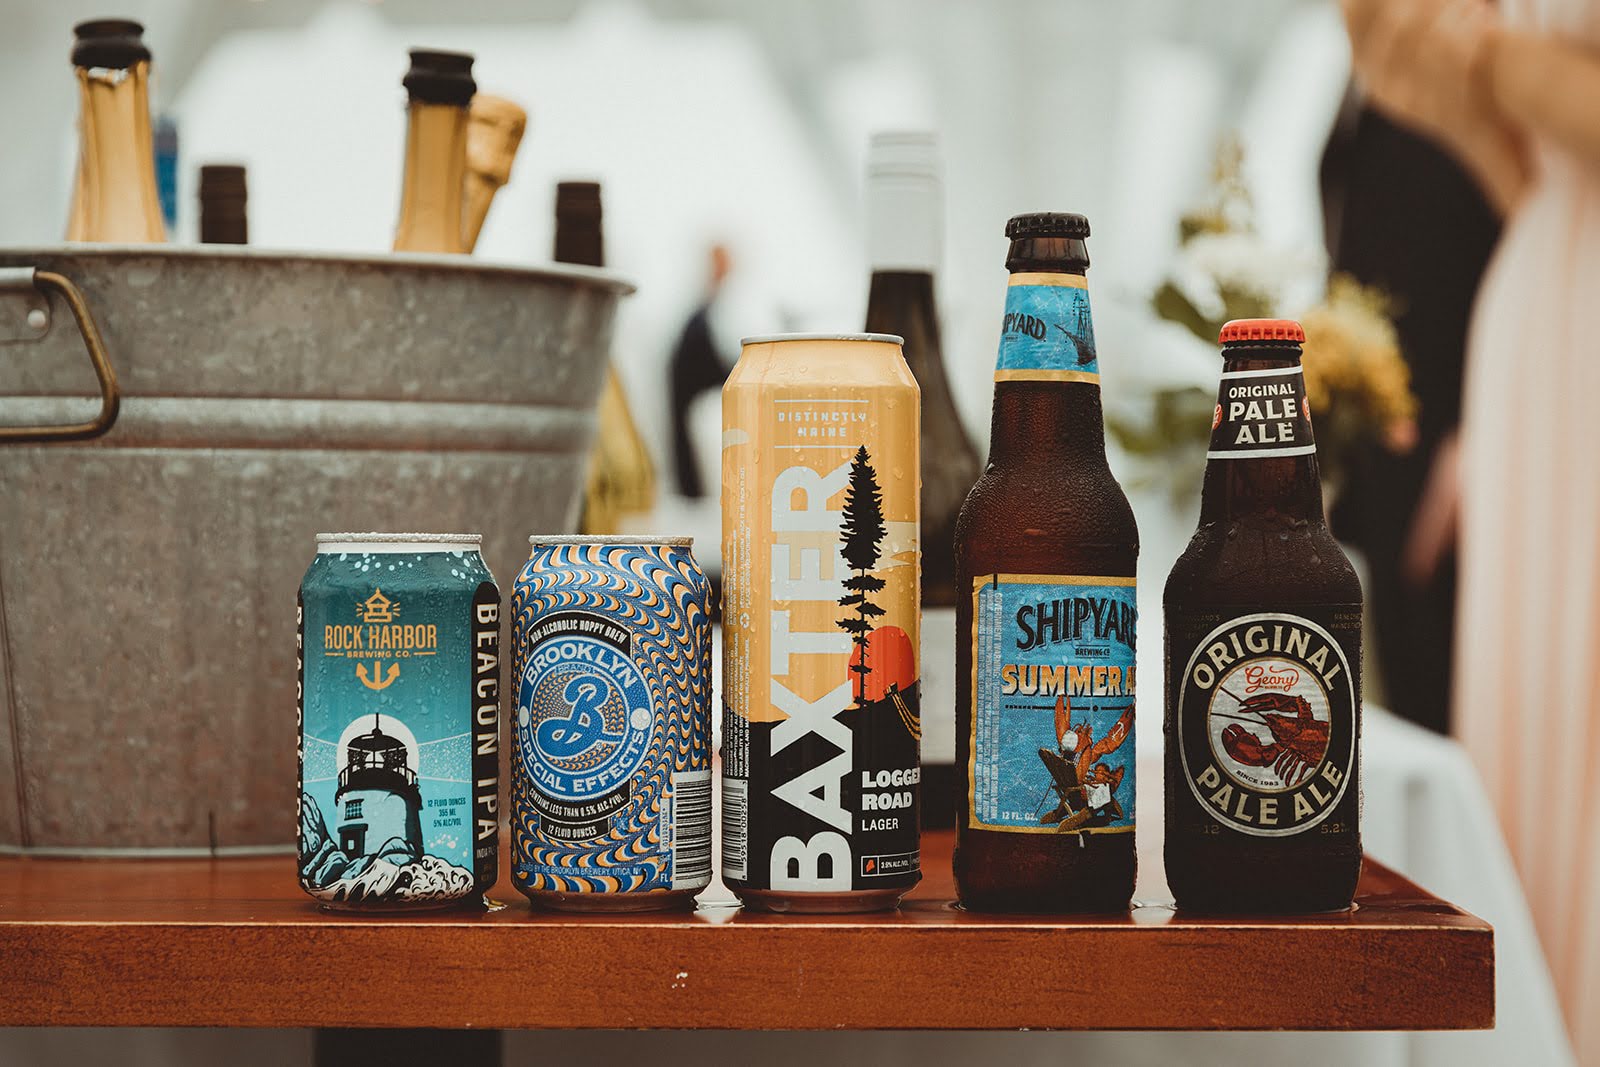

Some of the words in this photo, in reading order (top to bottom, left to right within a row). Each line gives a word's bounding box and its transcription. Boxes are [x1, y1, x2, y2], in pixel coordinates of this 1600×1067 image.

[1229, 383, 1295, 399] ORIGINAL
[778, 411, 866, 422] DISTINCTLY
[1229, 398, 1298, 422] PALE
[797, 427, 847, 437] MAINE
[1234, 422, 1295, 445] ALE
[325, 624, 363, 650] ROCK
[368, 624, 437, 650] HARBOR
[529, 619, 578, 644] NON-ALCOHOLIC
[579, 619, 606, 634] HOPPY
[604, 625, 628, 644] BREW
[346, 650, 392, 658] BREWING
[1075, 648, 1102, 656] BREWING
[1193, 625, 1342, 692] ORIGINAL
[525, 642, 638, 689] BROOKLYN
[770, 459, 853, 890] BAXTER
[476, 603, 499, 756] BEACON
[1001, 664, 1122, 698] SUMMER
[1244, 665, 1300, 694] Geary
[521, 729, 566, 793] SPECIAL
[572, 730, 645, 793] EFFECTS
[1236, 770, 1258, 784] SINCE
[434, 798, 447, 807] FLUID
[448, 797, 466, 806] OUNCES
[528, 788, 549, 810] CONTAINS
[548, 803, 562, 816] LESS
[563, 806, 580, 817] THAN
[580, 805, 597, 817] 0.5%
[862, 792, 913, 811] ROAD
[1196, 763, 1279, 825] PALE
[1294, 760, 1343, 822] ALE
[439, 808, 448, 817] 355
[477, 777, 498, 841] IPA
[1002, 811, 1009, 820] 12
[433, 819, 442, 828] 5%
[547, 824, 554, 833] 12
[554, 826, 571, 838] FLUID
[572, 825, 598, 839] OUNCES
[862, 818, 899, 831] LAGER
[551, 867, 580, 875] BROOKLYN
